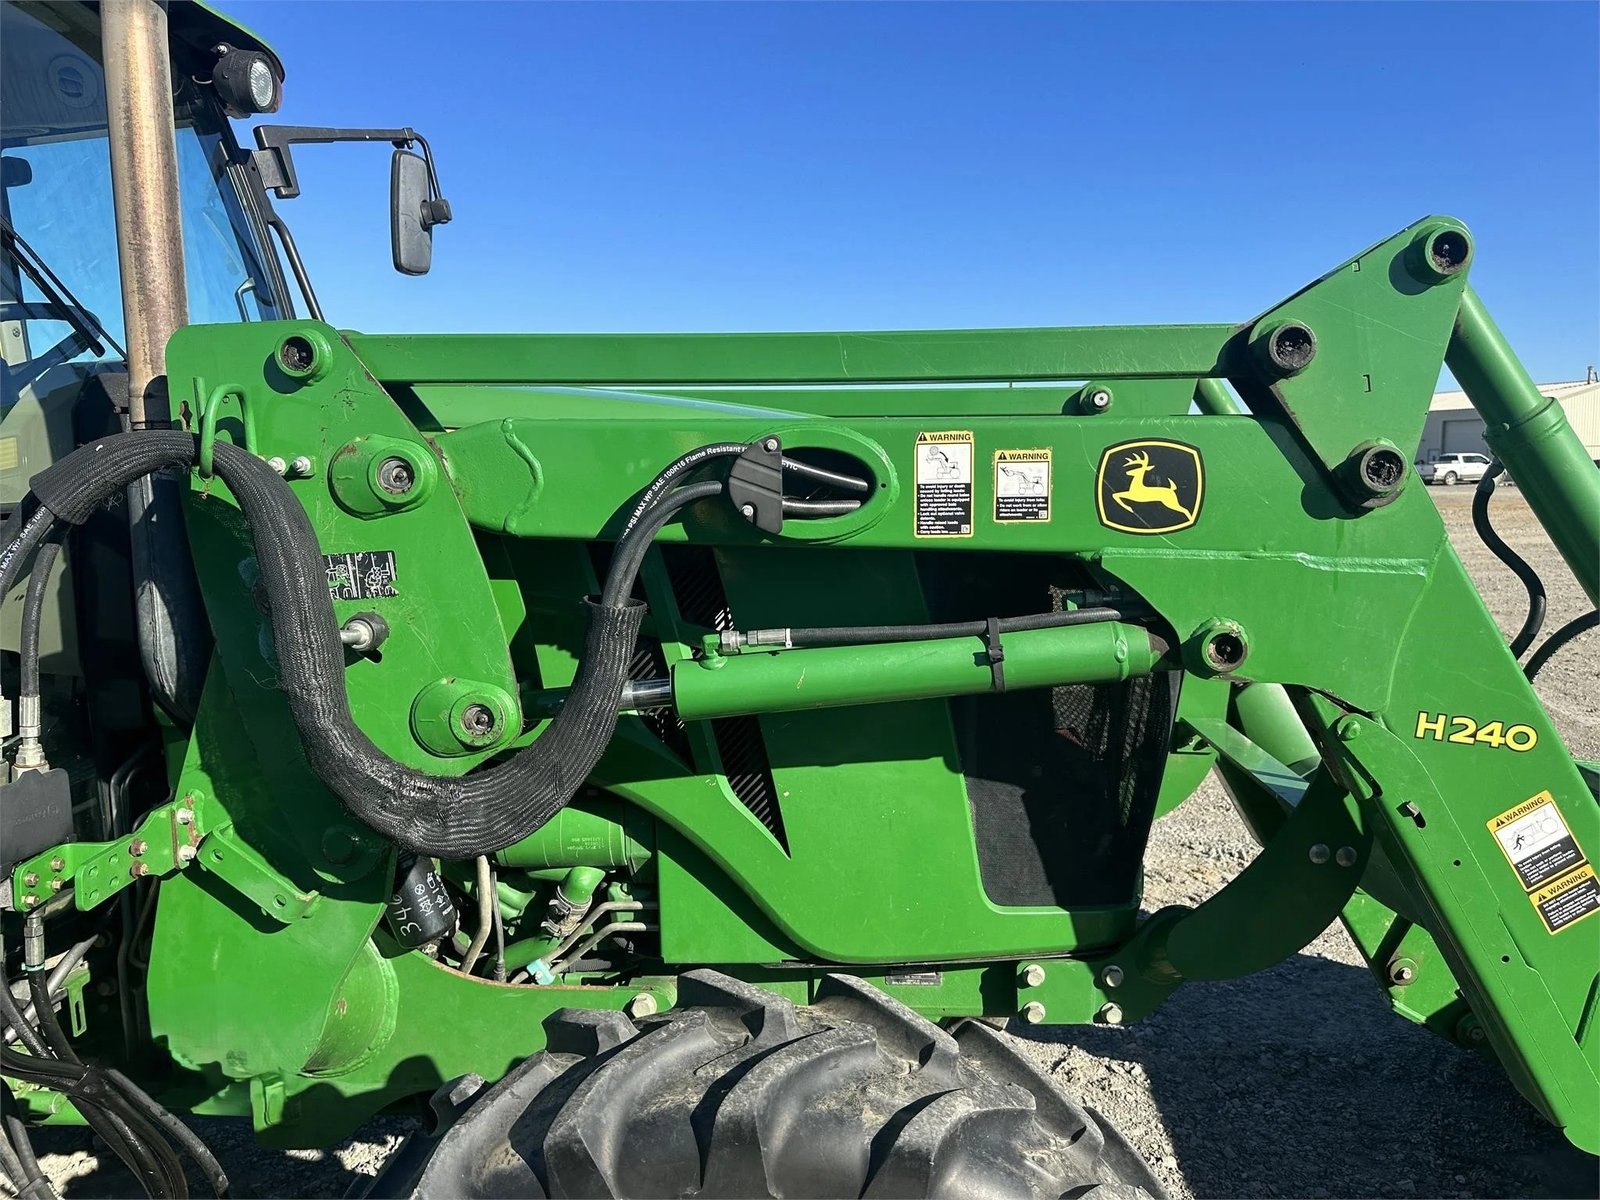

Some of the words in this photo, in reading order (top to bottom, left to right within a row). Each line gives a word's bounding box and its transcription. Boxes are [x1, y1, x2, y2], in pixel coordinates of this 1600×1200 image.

[628, 515, 637, 528] PSI
[635, 502, 647, 518] MAX
[644, 490, 653, 502] WP
[652, 478, 665, 492] SAE
[685, 451, 706, 464] Flame
[706, 446, 740, 454] Resistant
[1, 552, 14, 569] MAX
[11, 538, 20, 551] WP
[20, 523, 33, 538] SAE
[1415, 711, 1538, 752] H240
[1504, 797, 1544, 821] WARNING
[1548, 871, 1588, 895] WARNING
